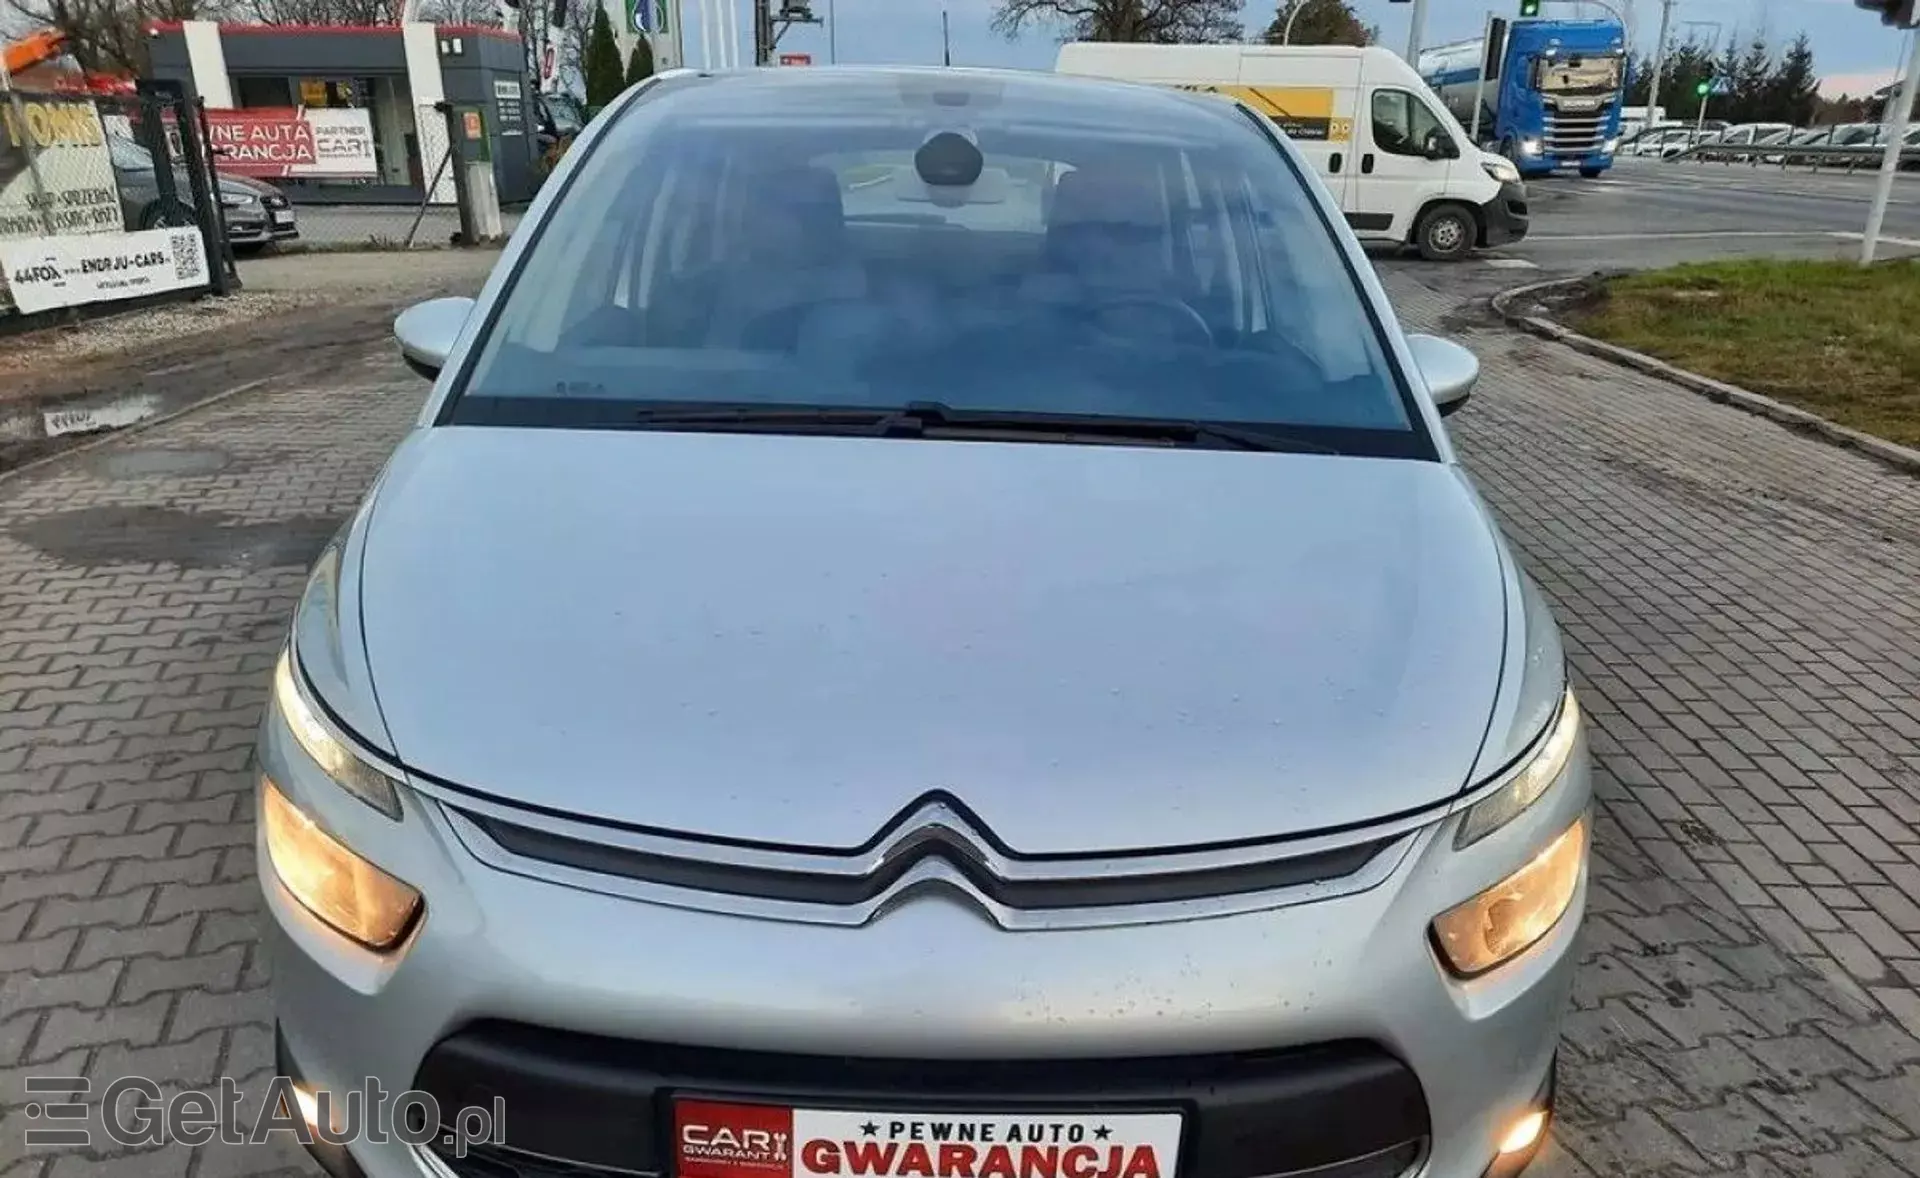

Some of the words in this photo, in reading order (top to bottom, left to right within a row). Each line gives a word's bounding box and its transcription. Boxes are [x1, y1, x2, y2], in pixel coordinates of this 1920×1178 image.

[251, 124, 311, 142] AUTA
[317, 138, 362, 152] CAR
[682, 1125, 770, 1150] CAR
[889, 1121, 996, 1142] PEWNE
[1006, 1123, 1085, 1143] AUTO
[683, 1144, 770, 1160] GWARANT
[801, 1139, 1161, 1178] GWARANCJA
